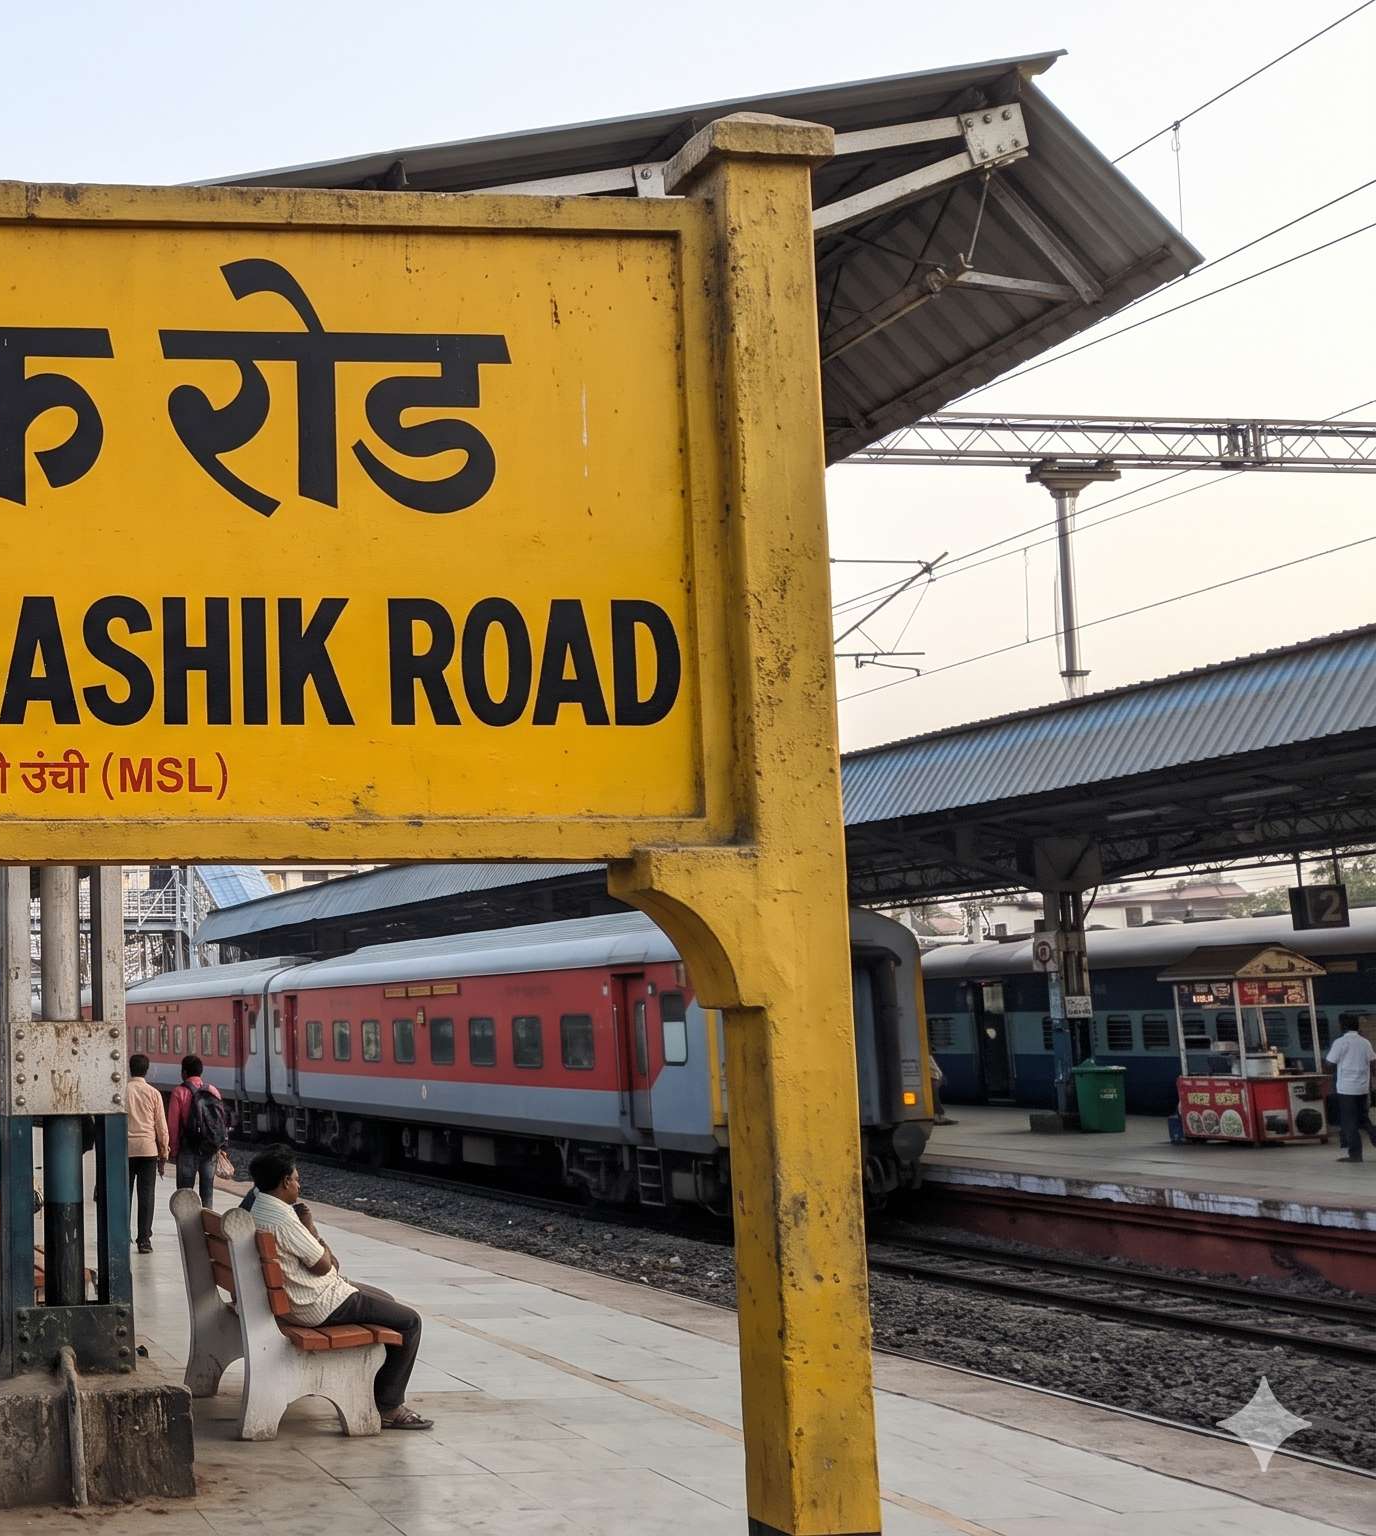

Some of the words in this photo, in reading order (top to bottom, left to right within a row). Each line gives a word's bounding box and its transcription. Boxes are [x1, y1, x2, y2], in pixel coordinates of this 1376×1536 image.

[159, 259, 511, 517] रोड
[388, 597, 681, 726] ROAD
[20, 749, 89, 795] उंची
[102, 752, 228, 800] (MSL)
[1319, 890, 1342, 921] 2
